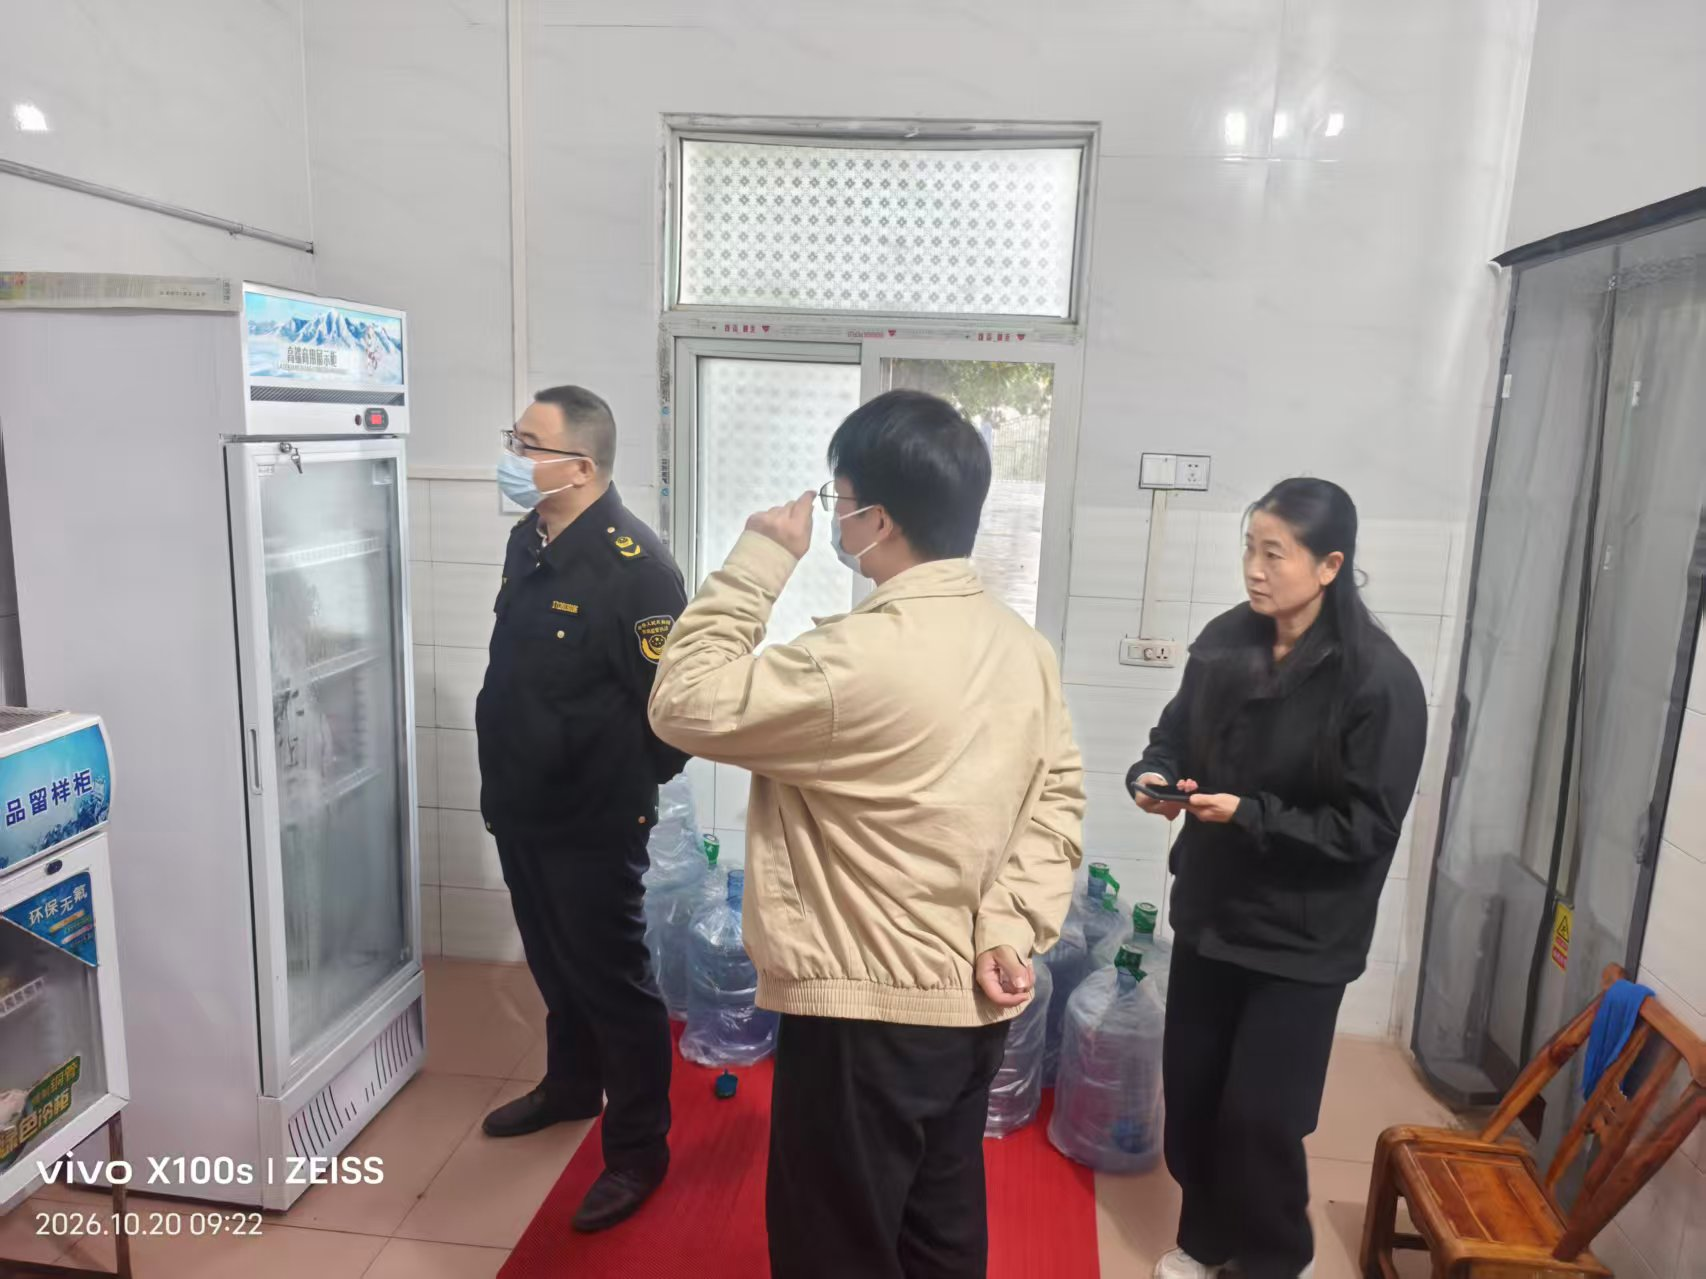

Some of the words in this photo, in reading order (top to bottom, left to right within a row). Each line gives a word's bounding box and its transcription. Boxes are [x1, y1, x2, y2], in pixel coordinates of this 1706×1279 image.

[6, 769, 92, 826] 品留样柜
[28, 884, 88, 926] 环保无氟
